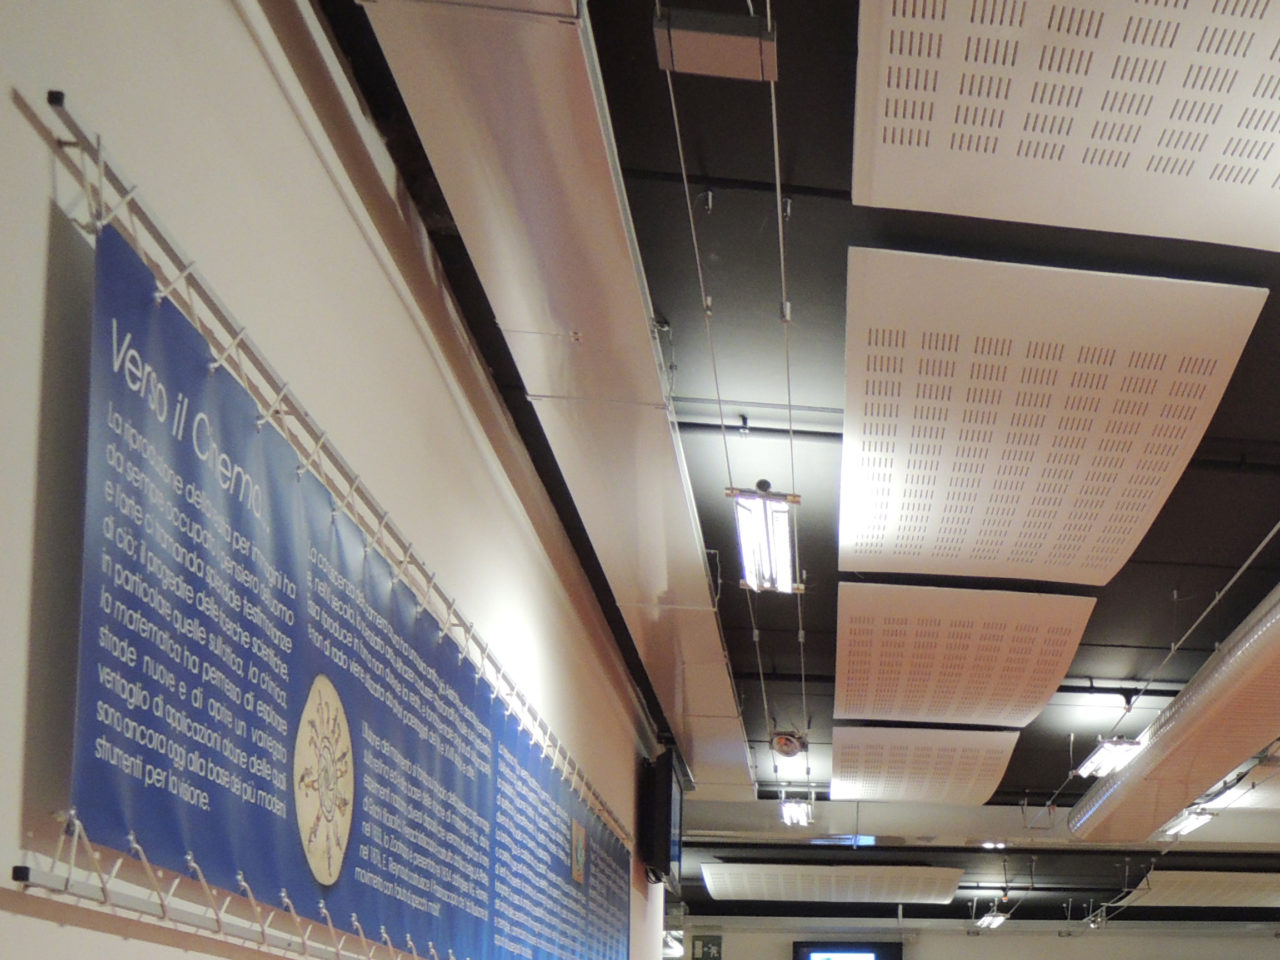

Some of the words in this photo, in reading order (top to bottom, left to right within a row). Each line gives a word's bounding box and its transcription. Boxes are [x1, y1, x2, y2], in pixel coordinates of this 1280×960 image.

[112, 318, 167, 423] Verso
[172, 393, 189, 441] il
[105, 480, 114, 501] e
[106, 443, 124, 474] da
[108, 401, 122, 434] La
[232, 531, 251, 557] per
[283, 573, 296, 600] ha
[102, 546, 112, 576] in
[114, 563, 171, 621] particolare
[173, 609, 207, 645] quelle
[248, 660, 259, 684] la
[103, 514, 115, 540] di
[140, 539, 146, 565] il
[196, 590, 219, 622] delle
[98, 624, 137, 667] strade
[142, 655, 175, 692] nuove
[179, 681, 187, 700] e
[191, 686, 203, 709] di
[234, 718, 247, 738] un
[100, 584, 112, 614] la
[114, 601, 181, 663] matematica
[184, 645, 199, 675] ha
[202, 662, 242, 704] permesso
[243, 691, 255, 712] di
[95, 735, 143, 780] strumenti
[144, 764, 167, 789] per
[168, 768, 178, 794] la
[178, 778, 211, 812] visione.
[96, 700, 122, 732] sono
[123, 717, 166, 754] ancora
[167, 740, 186, 771] oggi
[187, 750, 206, 777] alla
[207, 757, 230, 788] base
[241, 779, 256, 803] più
[98, 662, 150, 710] ventaglio
[153, 694, 164, 718] di
[165, 704, 221, 751] applicazioni
[248, 753, 272, 780] delle
